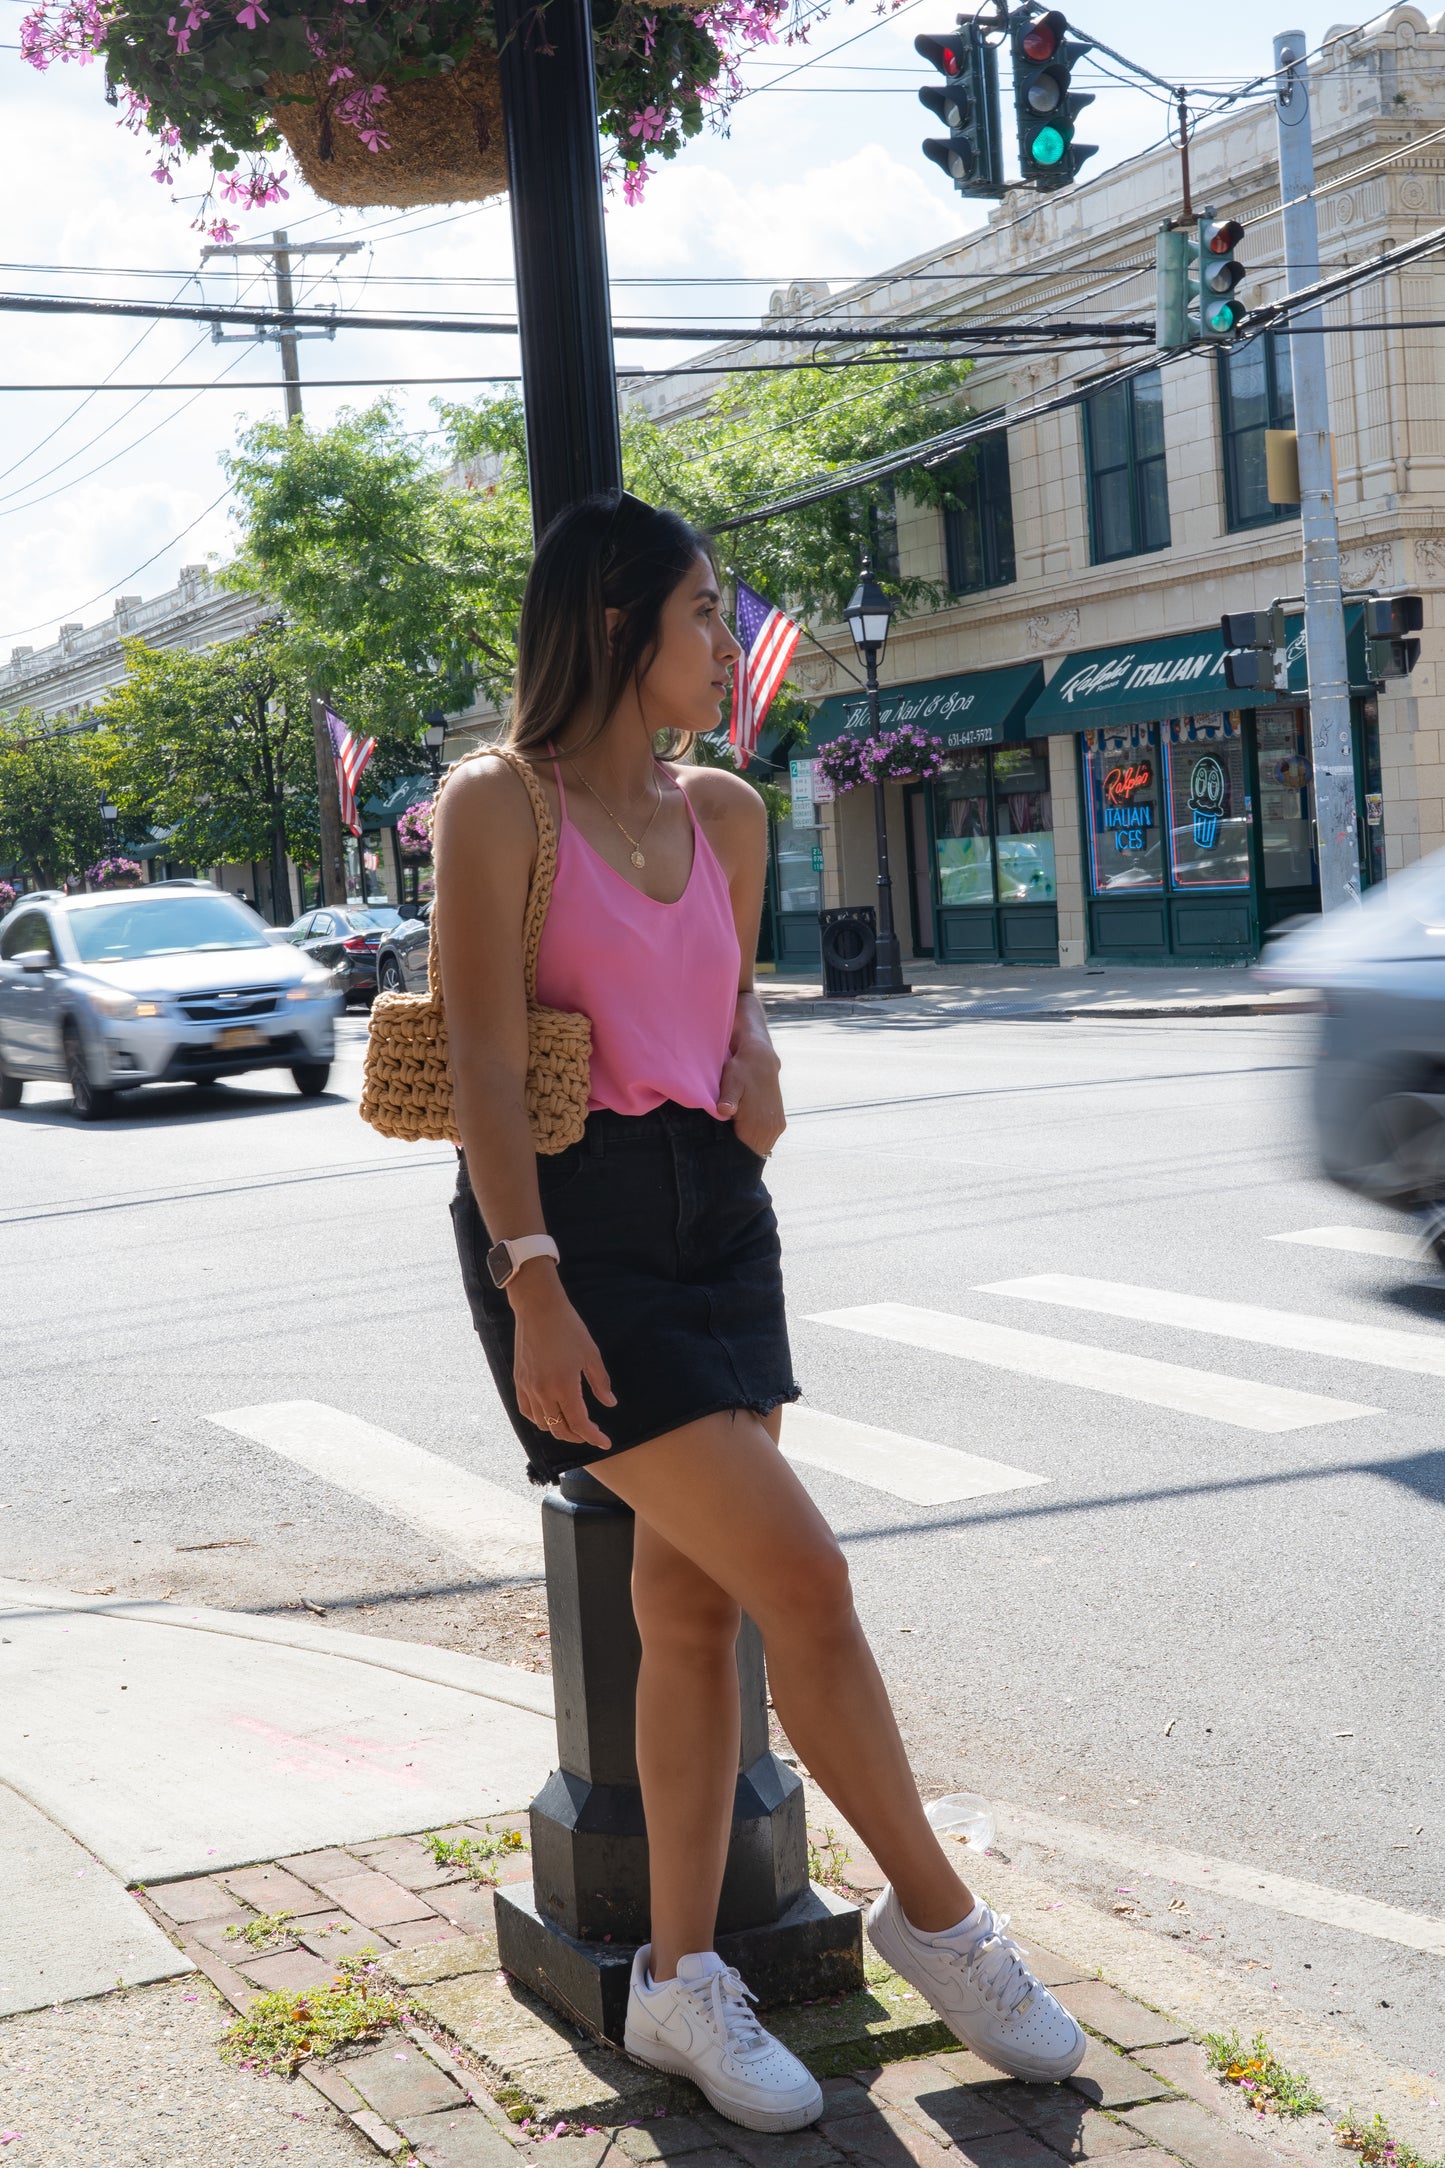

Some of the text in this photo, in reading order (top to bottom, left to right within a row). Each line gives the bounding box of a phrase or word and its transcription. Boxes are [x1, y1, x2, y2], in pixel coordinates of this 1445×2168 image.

[1123, 654, 1212, 689] ITALIAN
[891, 696, 929, 722] Nail
[923, 694, 946, 717] &
[940, 691, 975, 721] Spa
[948, 727, 993, 746] 631-647-5522
[1104, 805, 1151, 828] ITALIAN
[1115, 829, 1143, 850] ICES
